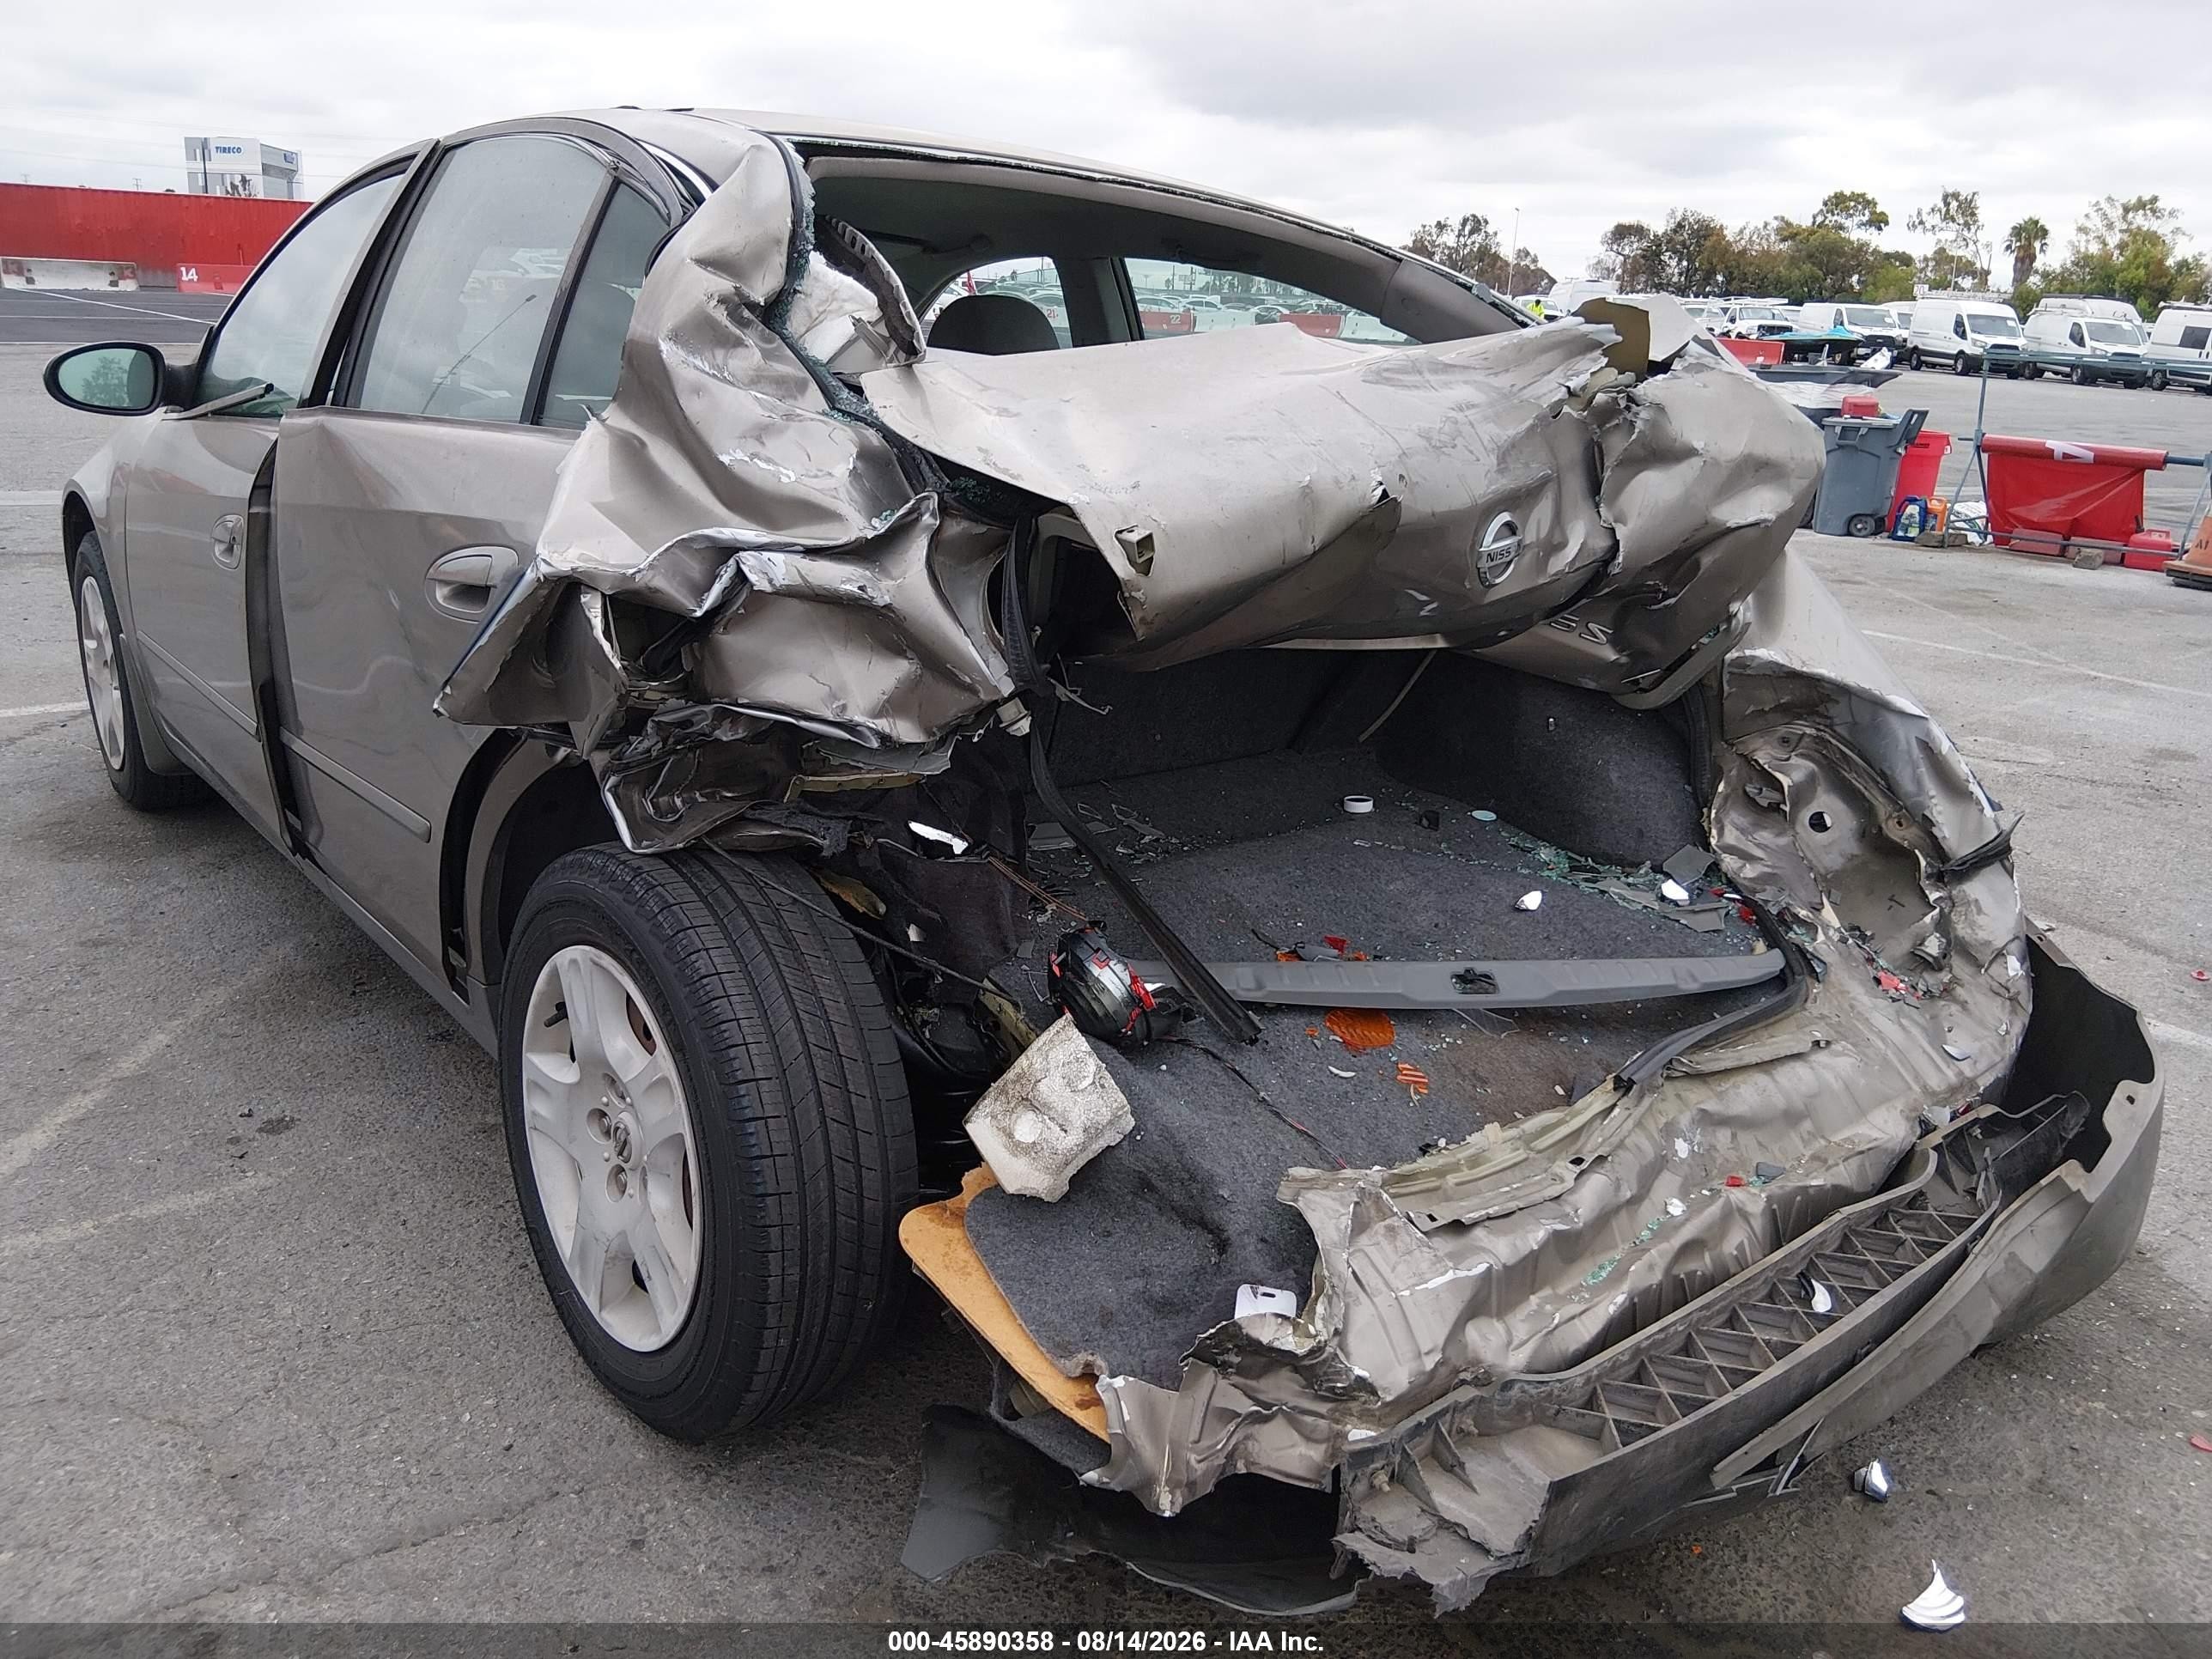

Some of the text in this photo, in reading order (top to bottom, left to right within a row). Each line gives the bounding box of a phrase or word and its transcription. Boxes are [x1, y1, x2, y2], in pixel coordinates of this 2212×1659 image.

[180, 266, 198, 282] 14
[1047, 308, 1056, 319] 21
[1170, 314, 1182, 324] 22
[1486, 546, 1516, 563] NISS
